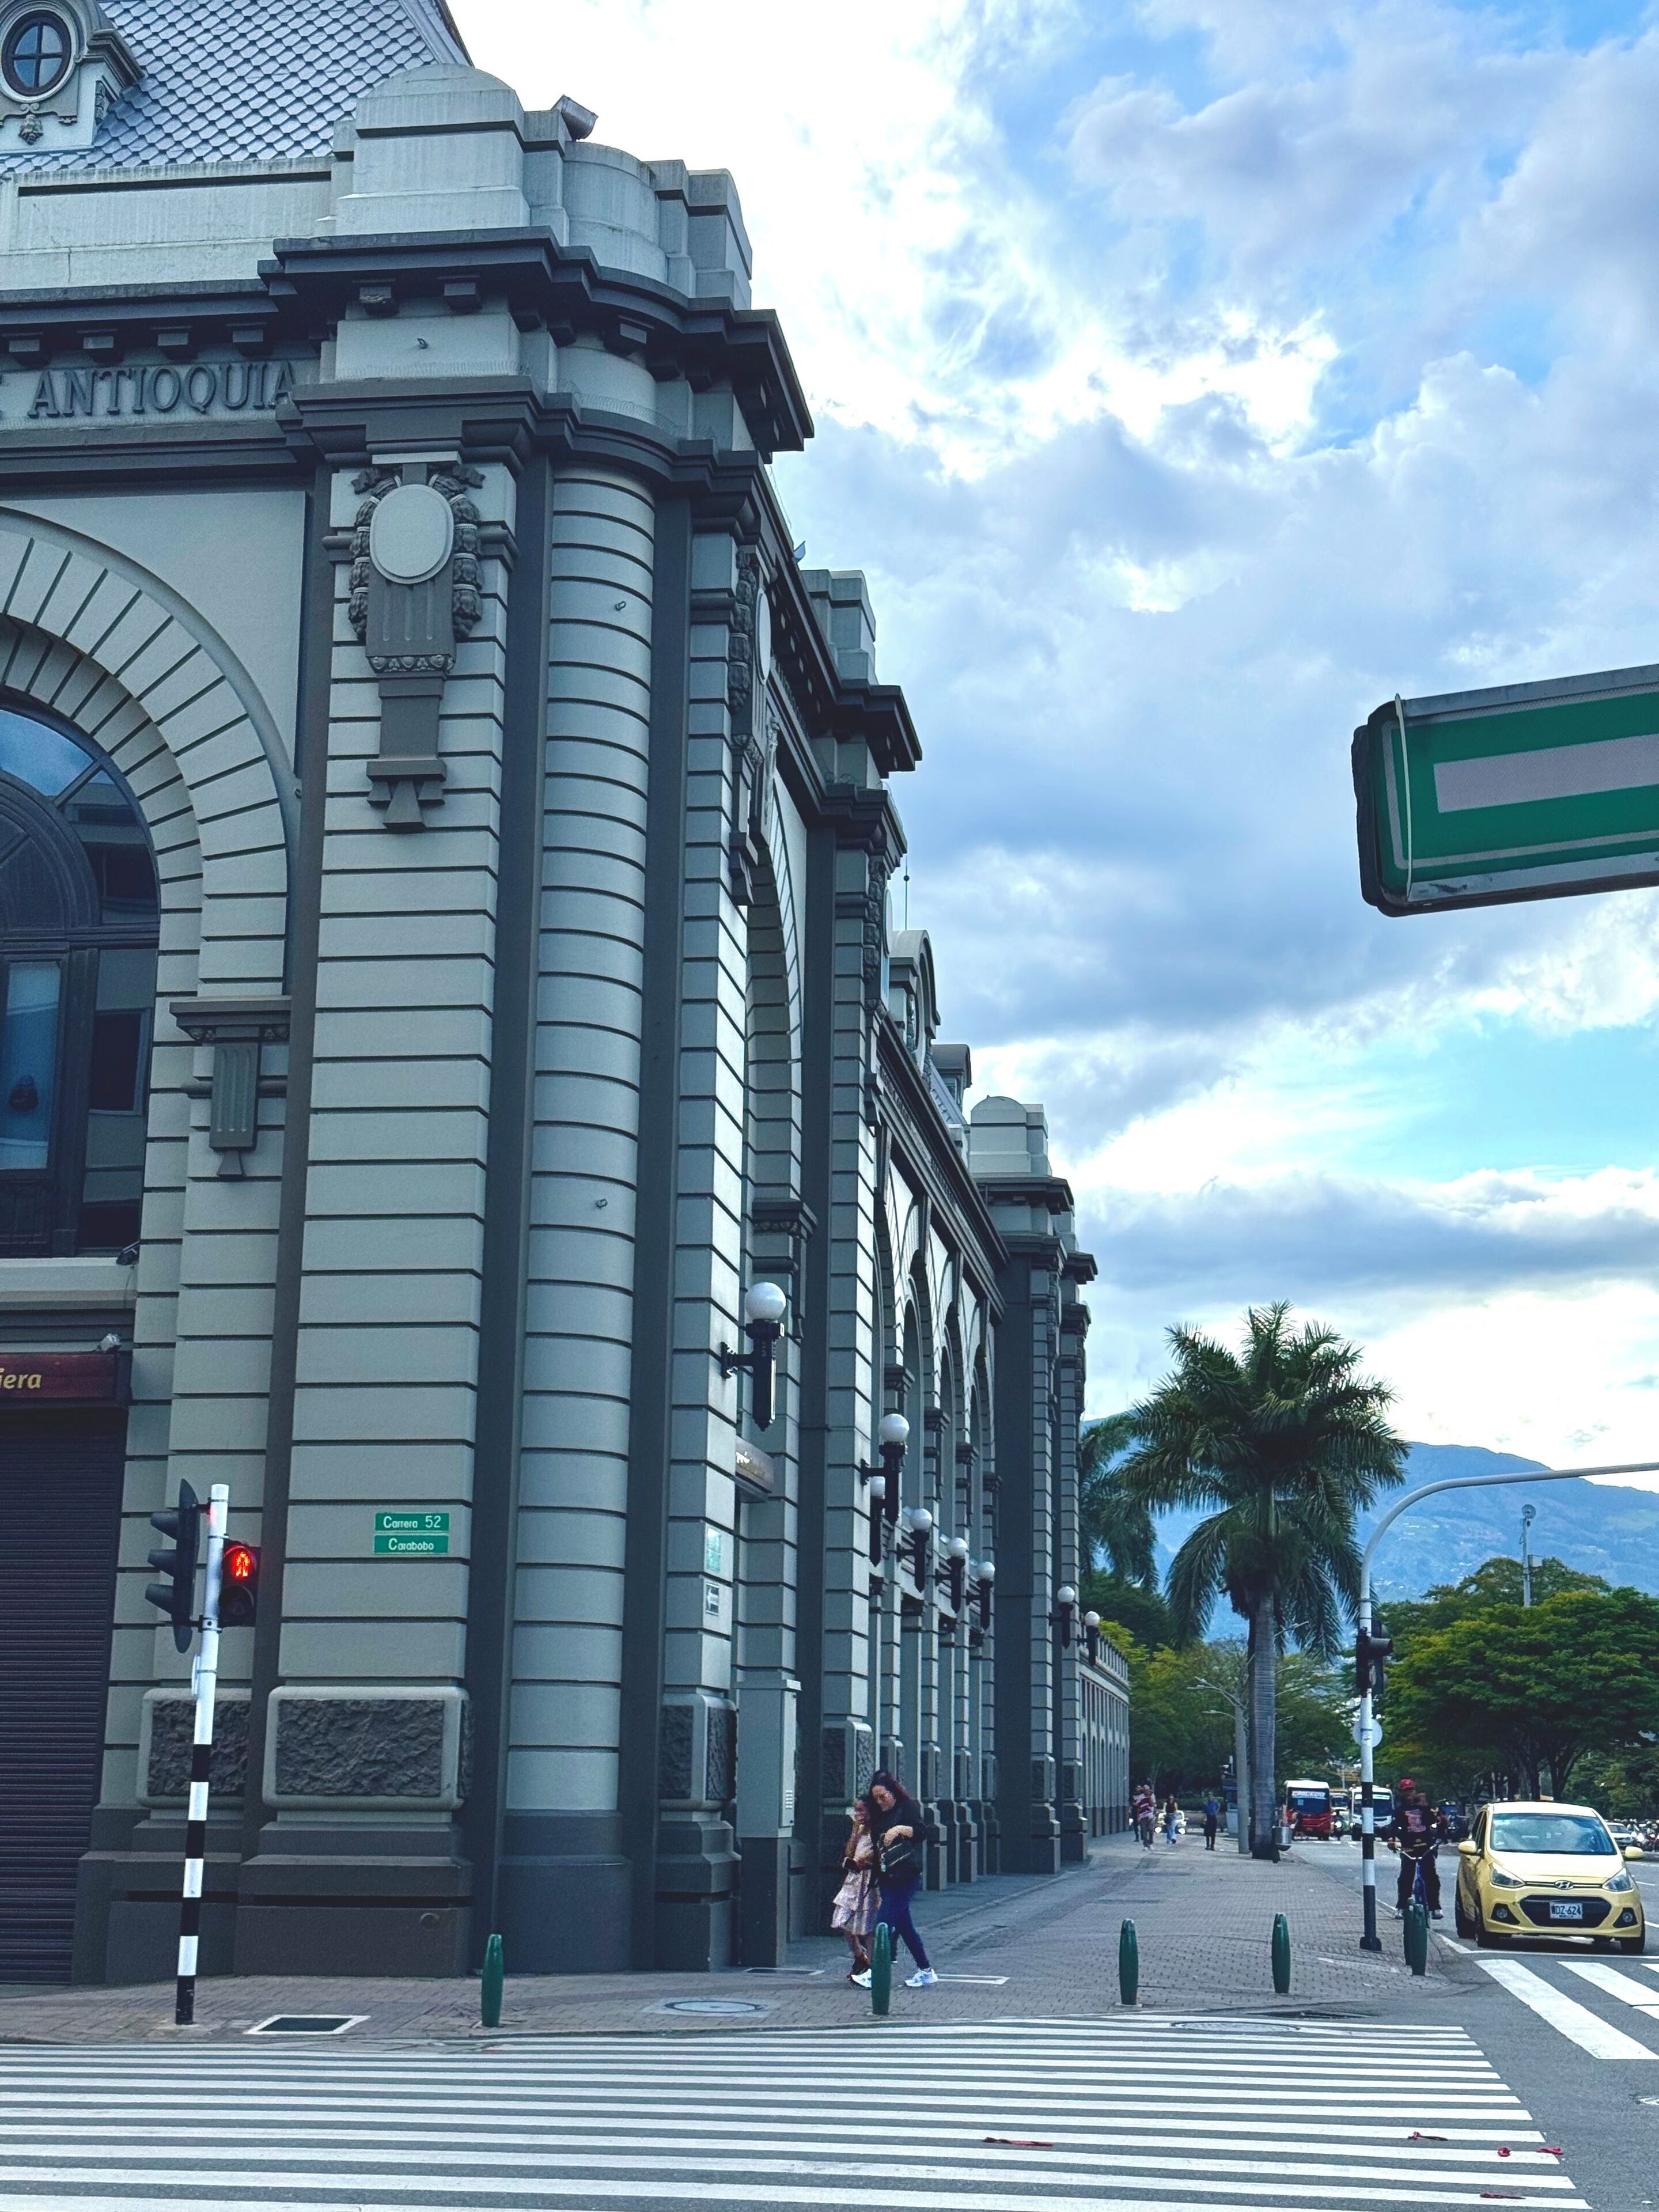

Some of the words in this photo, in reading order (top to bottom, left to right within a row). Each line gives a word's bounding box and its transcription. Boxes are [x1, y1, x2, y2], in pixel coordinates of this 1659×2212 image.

[27, 361, 295, 418] ANTIOQUIA
[383, 1516, 418, 1528] Carrera
[425, 1515, 441, 1528] 52
[388, 1537, 434, 1550] Carabobo
